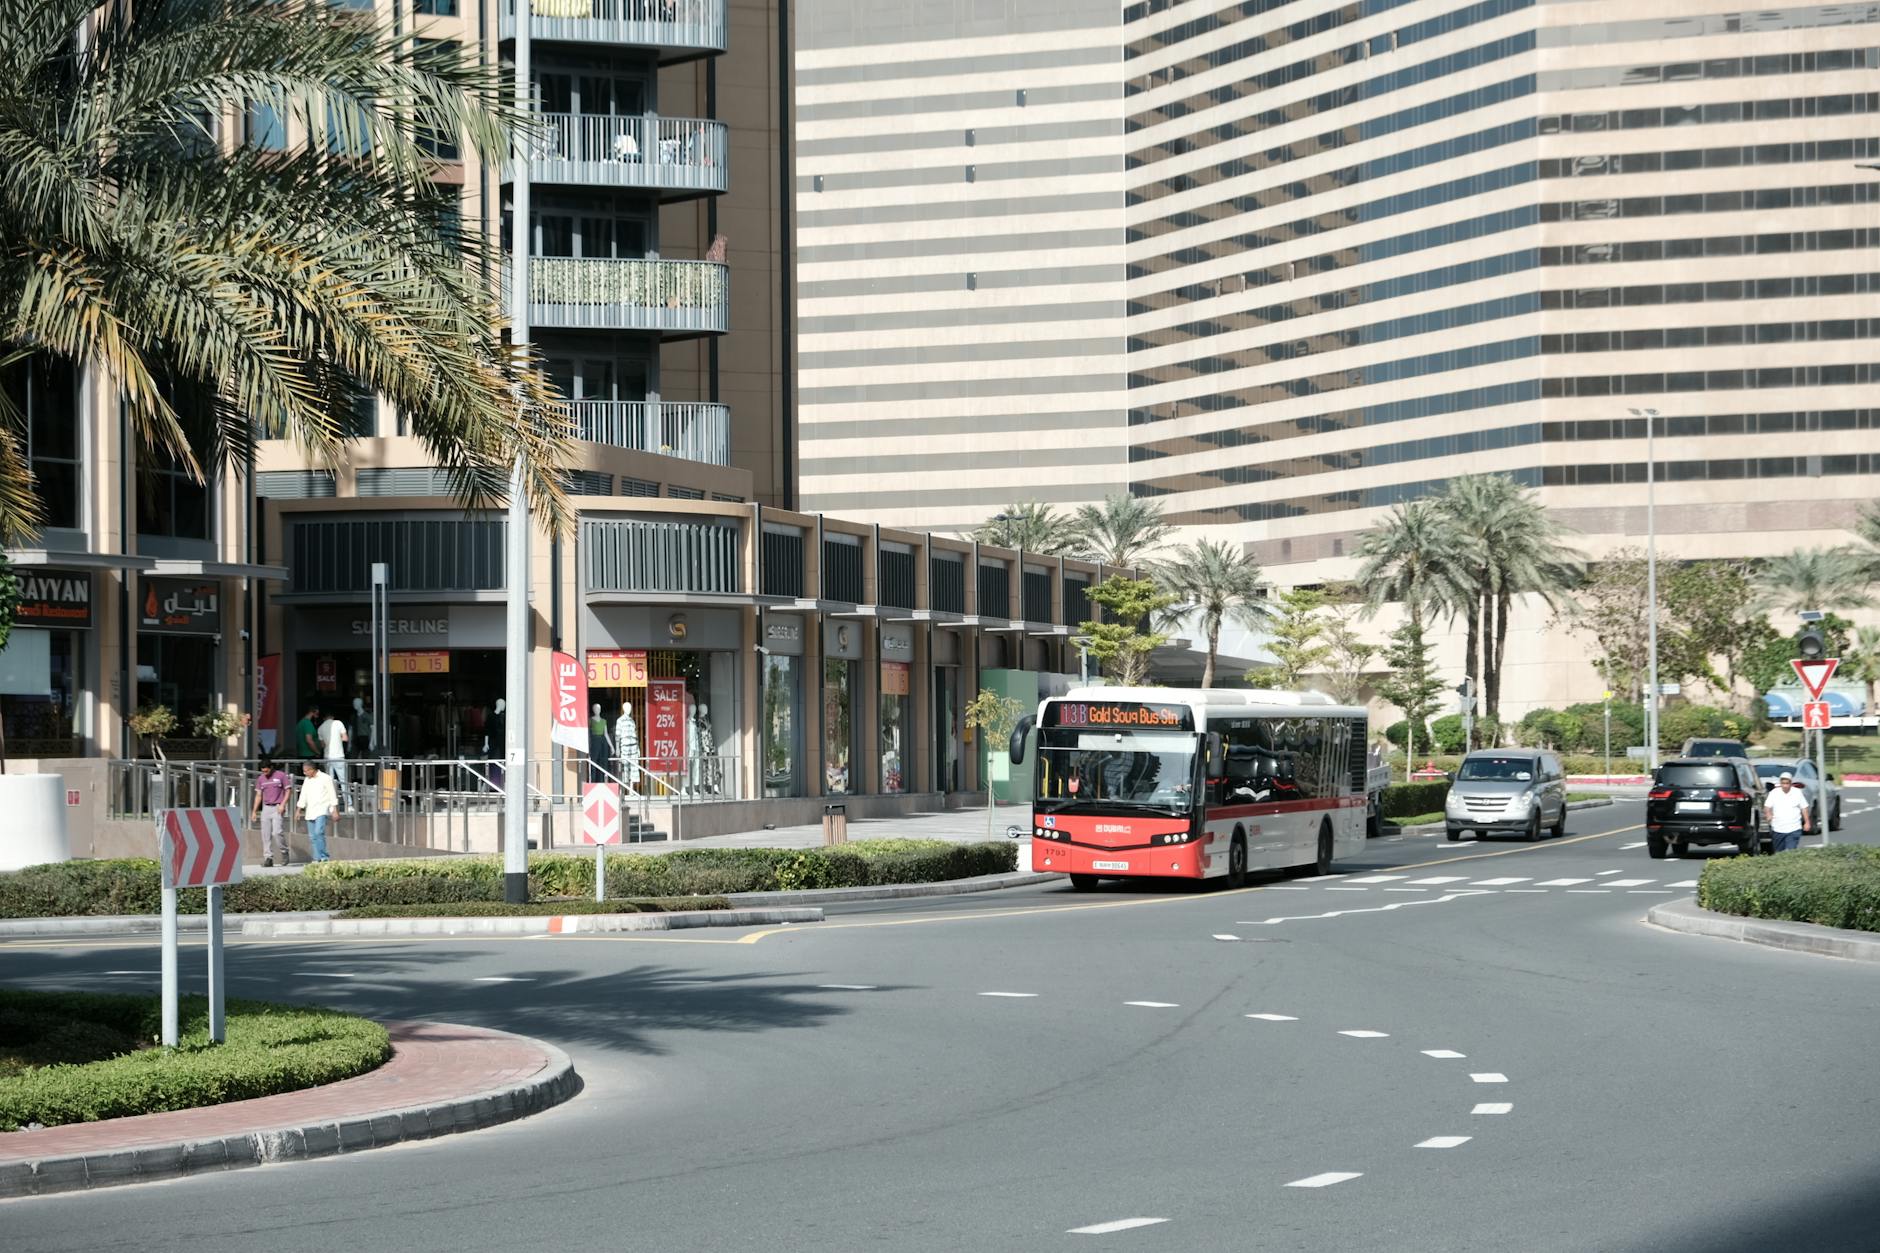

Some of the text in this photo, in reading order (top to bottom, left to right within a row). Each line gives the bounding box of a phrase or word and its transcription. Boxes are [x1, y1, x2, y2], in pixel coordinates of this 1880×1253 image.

[352, 620, 449, 634] SUERLINE
[403, 658, 442, 671] 10 15
[588, 663, 644, 680] 5 10 15
[653, 690, 678, 701] SALE
[656, 714, 675, 728] 25%
[1063, 703, 1179, 725] 13B Gold Souq Bus Stn
[654, 740, 678, 757] 75%
